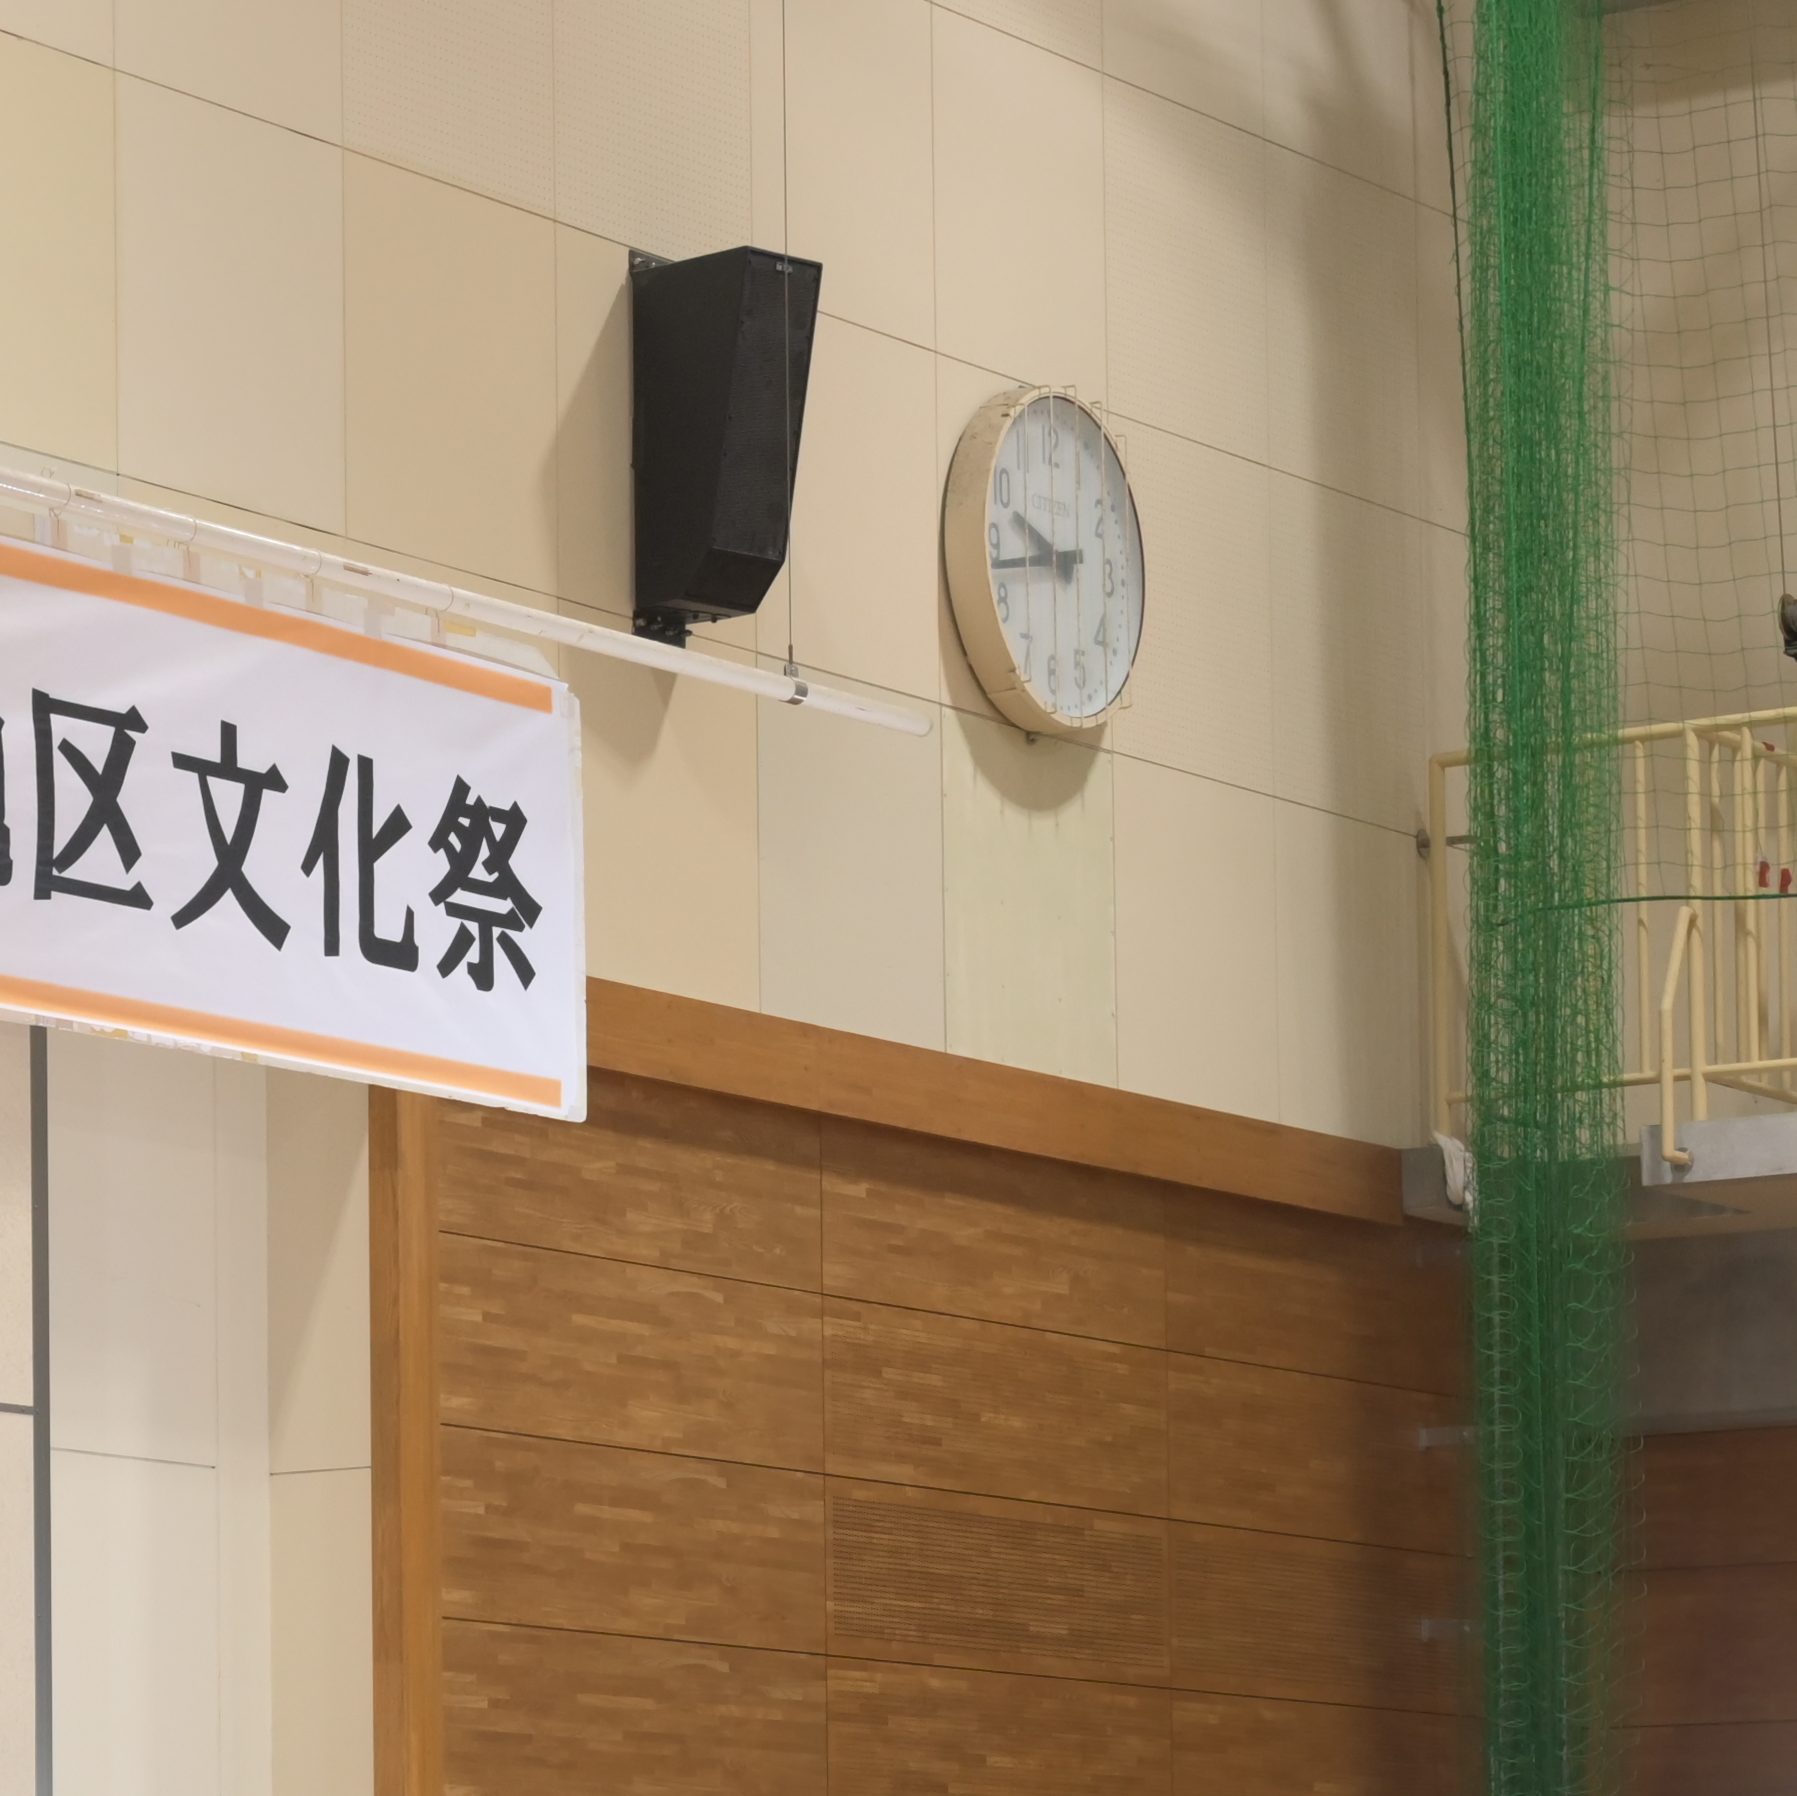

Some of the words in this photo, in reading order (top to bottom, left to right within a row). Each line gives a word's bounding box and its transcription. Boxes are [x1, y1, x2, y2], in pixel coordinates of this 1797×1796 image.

[1041, 424, 1060, 469] 12
[993, 465, 1011, 509] 10
[1104, 558, 1115, 598] 3
[997, 582, 1010, 623] 8
[1093, 612, 1109, 649] 4
[1047, 653, 1060, 696] 6
[1073, 648, 1087, 691] 5
